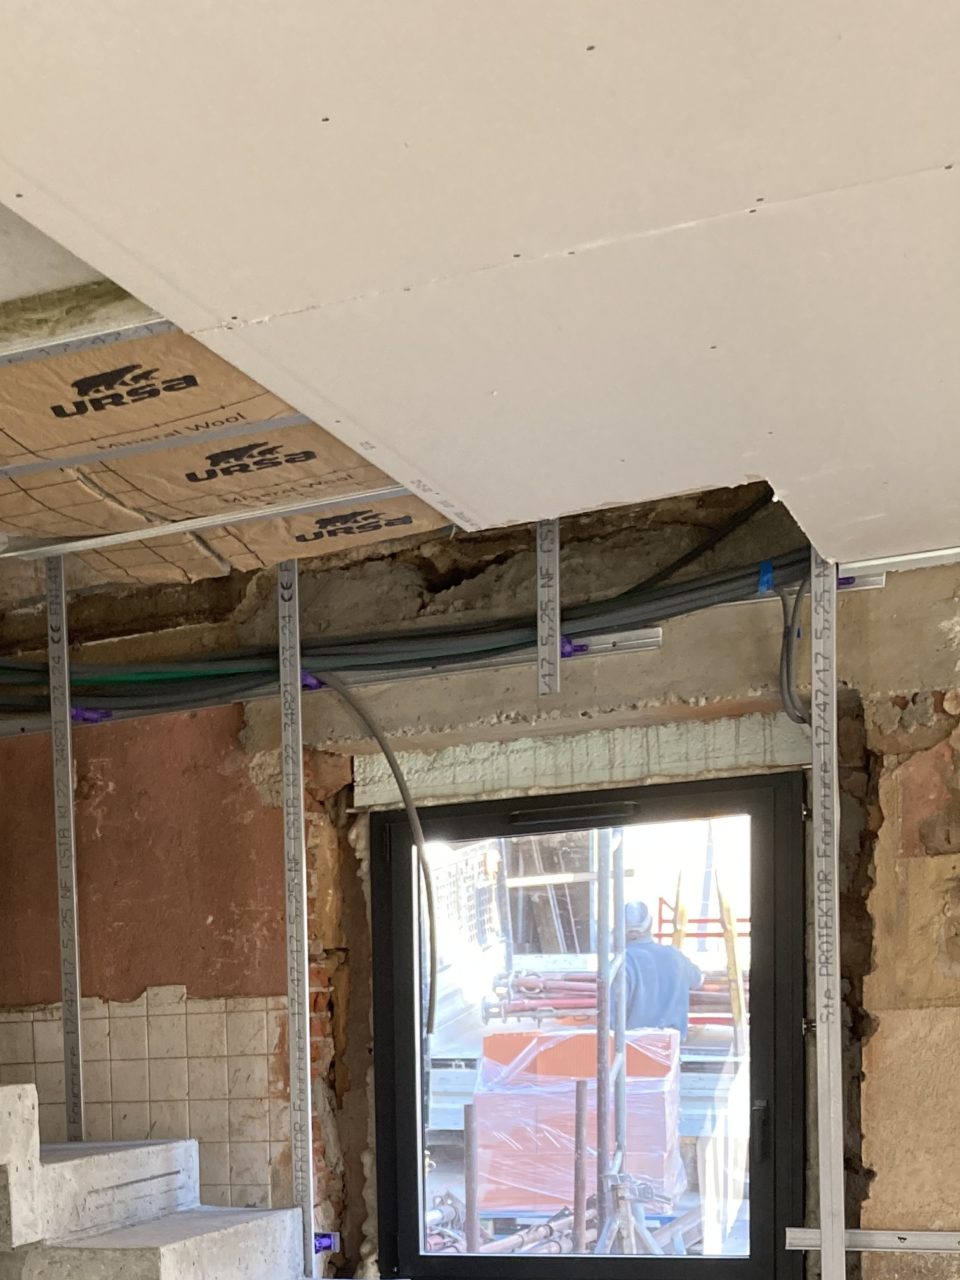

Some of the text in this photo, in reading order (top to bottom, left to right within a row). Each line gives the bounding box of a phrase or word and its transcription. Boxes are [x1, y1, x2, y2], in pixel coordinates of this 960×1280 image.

[185, 412, 248, 432] Wool
[302, 473, 355, 489] Wool
[540, 566, 553, 588] NF
[814, 652, 831, 749] 17/47/17
[817, 759, 833, 859] Fourrure
[287, 851, 300, 873] NF
[816, 870, 835, 977] PROTEKTOR
[289, 935, 303, 1017] 17/47/17
[819, 988, 835, 1025] Ste
[292, 1120, 308, 1207] ROTEKTOR
